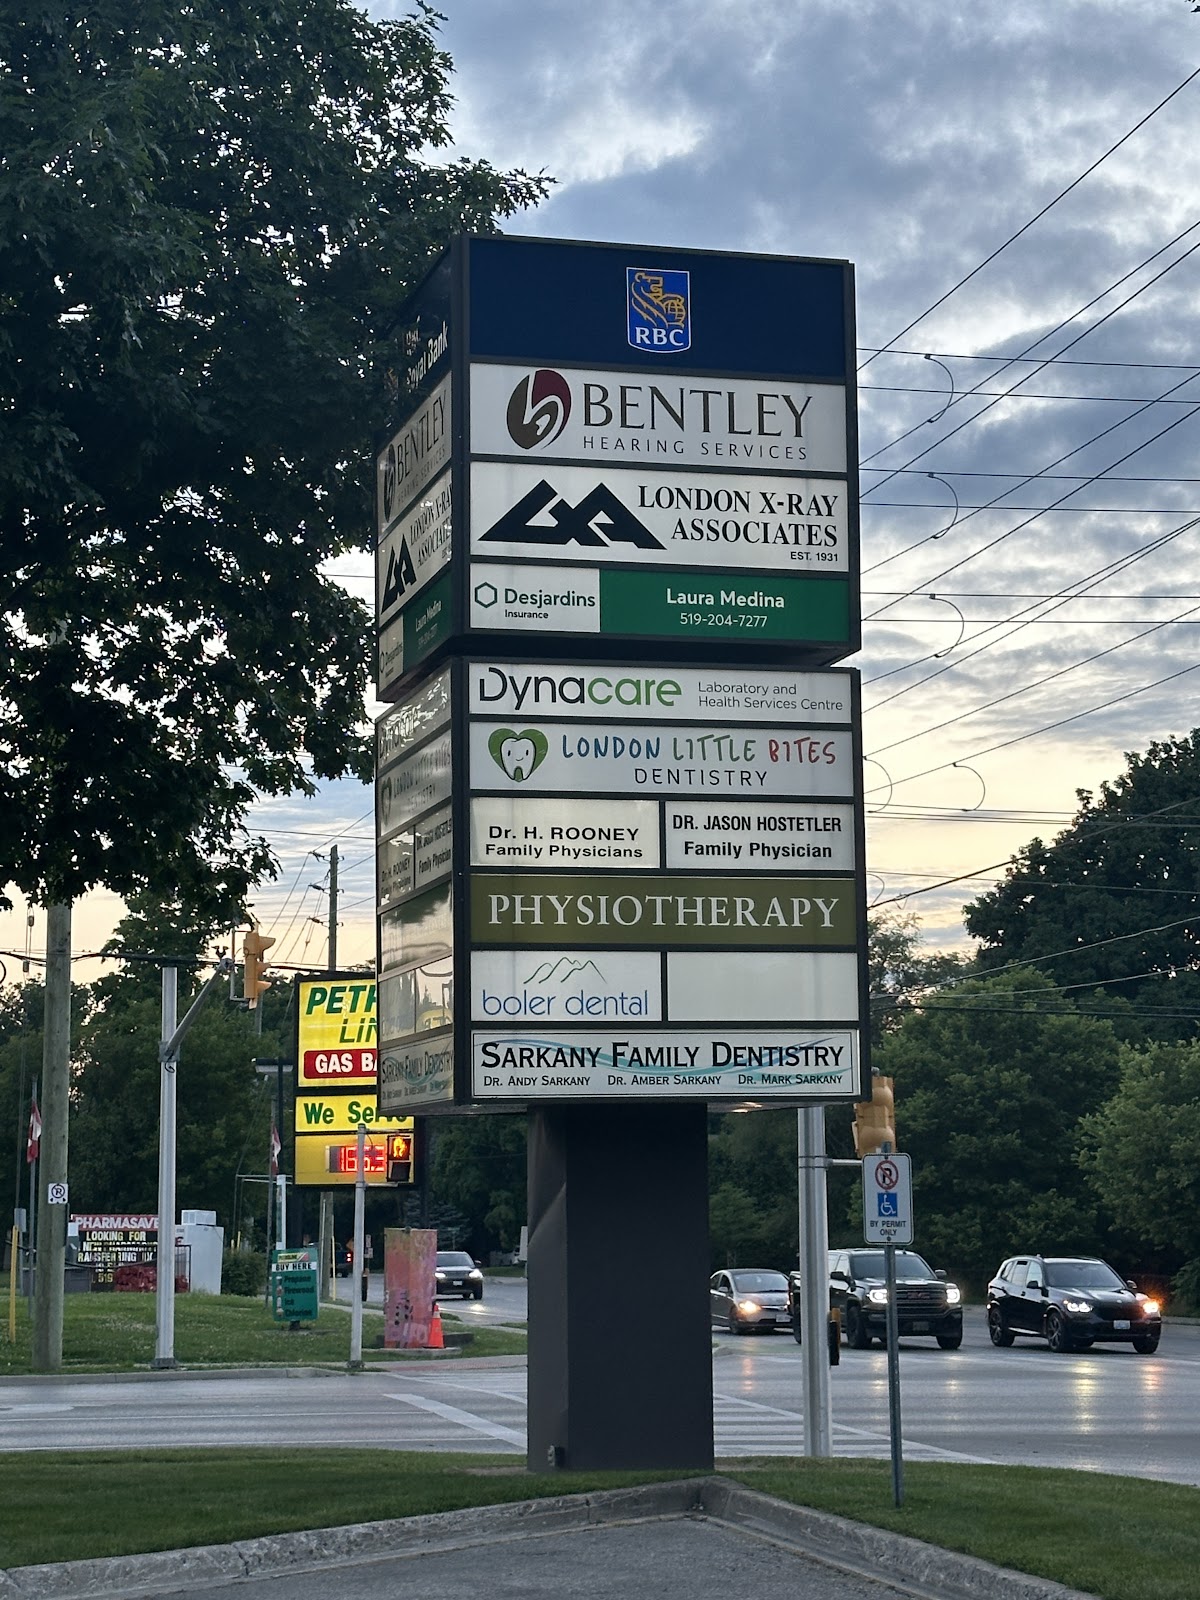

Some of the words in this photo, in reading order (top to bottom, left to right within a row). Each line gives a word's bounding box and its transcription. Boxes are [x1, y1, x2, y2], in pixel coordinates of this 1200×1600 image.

[635, 327, 684, 346] RBC
[583, 383, 813, 438] BENTLEY
[397, 389, 446, 486] BENTLEY
[583, 436, 684, 454] HEARING
[701, 442, 807, 460] SERVICES
[638, 485, 750, 513] LONDON
[759, 491, 839, 517] X-RAY
[671, 517, 838, 547] ASSOCIATES
[790, 551, 812, 561] EST.
[816, 553, 839, 562] 1931
[504, 588, 596, 608] Desjardins
[666, 588, 715, 606] Laura
[720, 590, 785, 608] Medina
[504, 609, 549, 619] Insurance
[680, 612, 768, 627] 519-204-7277
[479, 666, 682, 710] Dynacare
[698, 682, 769, 696] Laboratory
[773, 684, 797, 695] and
[699, 696, 740, 708] Health
[744, 697, 797, 709] Services
[801, 699, 843, 710] Centre
[562, 735, 660, 759] LONDON
[673, 734, 756, 762] LITTLE
[768, 736, 836, 764] BITES
[634, 768, 768, 786] DENTISTRY
[672, 815, 699, 830] DR.
[703, 815, 751, 831] JASON
[757, 816, 842, 832] HOSTETLER
[489, 826, 517, 839] Dr.
[524, 826, 543, 840] H.
[550, 827, 639, 841] ROONEY
[485, 843, 543, 858] Family
[549, 845, 643, 859] Physicians
[684, 841, 743, 859] Family
[749, 842, 832, 860] Physician
[488, 894, 839, 927] PHYSIOTHERAPY
[482, 989, 556, 1015] boler
[565, 989, 648, 1015] dental
[315, 1053, 354, 1074] GAS
[481, 1042, 602, 1068] SARKANY
[611, 1041, 700, 1068] FAMILY
[711, 1041, 844, 1067] DENTISTRY
[483, 1075, 503, 1086] DR.
[507, 1076, 538, 1086] ANDY
[541, 1075, 591, 1086] SARKANY
[608, 1075, 627, 1085] DR.
[631, 1075, 669, 1086] AMBER
[673, 1074, 722, 1085] SARKANY
[738, 1074, 757, 1085] DR.
[761, 1074, 792, 1085] MARK
[795, 1074, 843, 1085] SARKANY
[304, 1103, 334, 1124] We
[869, 1220, 879, 1228] BY
[881, 1220, 907, 1228] PERMIT
[879, 1228, 897, 1236] ONLY
[86, 1231, 124, 1241] LOOKING
[129, 1231, 147, 1241] FOR
[276, 1263, 290, 1271] BUY
[292, 1262, 312, 1270] HERE
